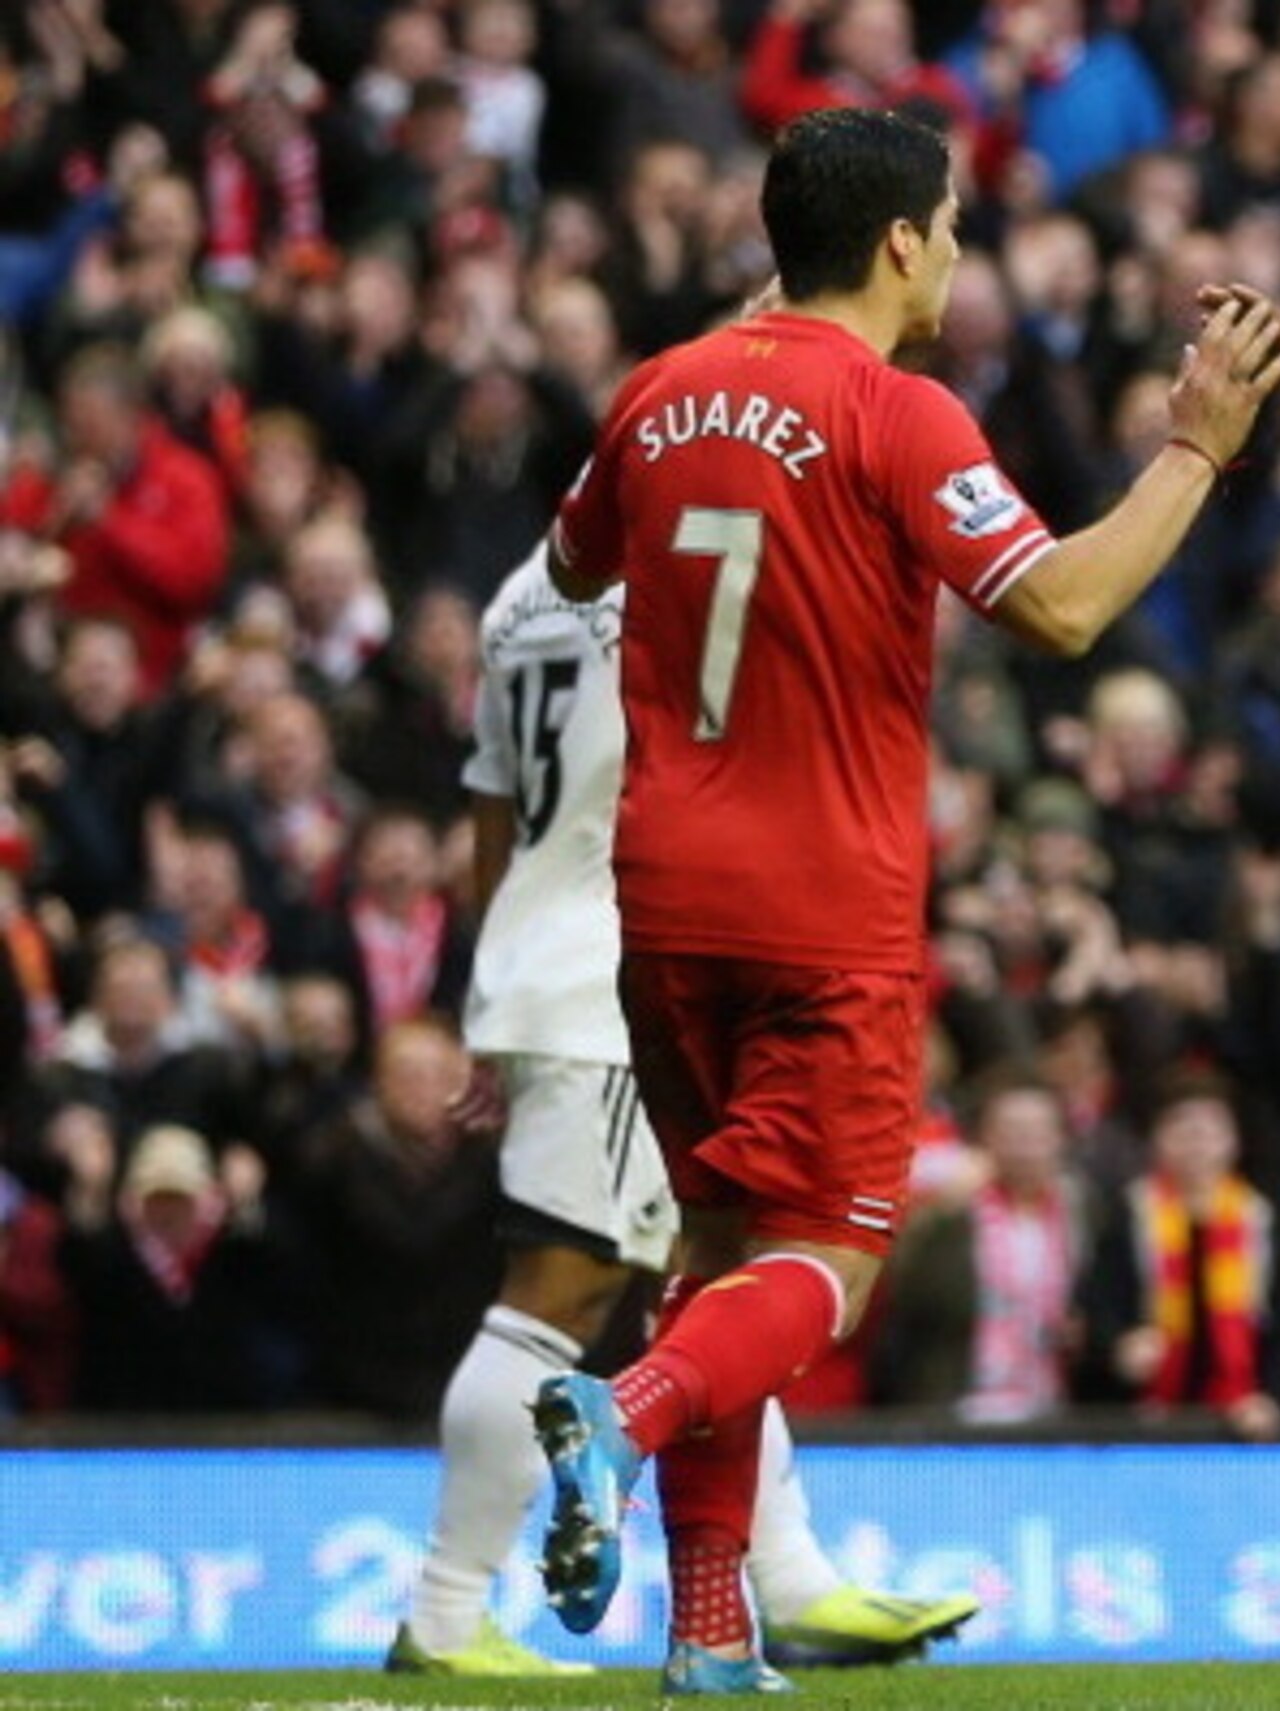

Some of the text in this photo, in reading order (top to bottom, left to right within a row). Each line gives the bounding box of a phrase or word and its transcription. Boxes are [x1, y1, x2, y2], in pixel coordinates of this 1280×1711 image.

[637, 390, 827, 480] SUAREZ
[672, 506, 764, 741] 7
[507, 655, 577, 847] 15
